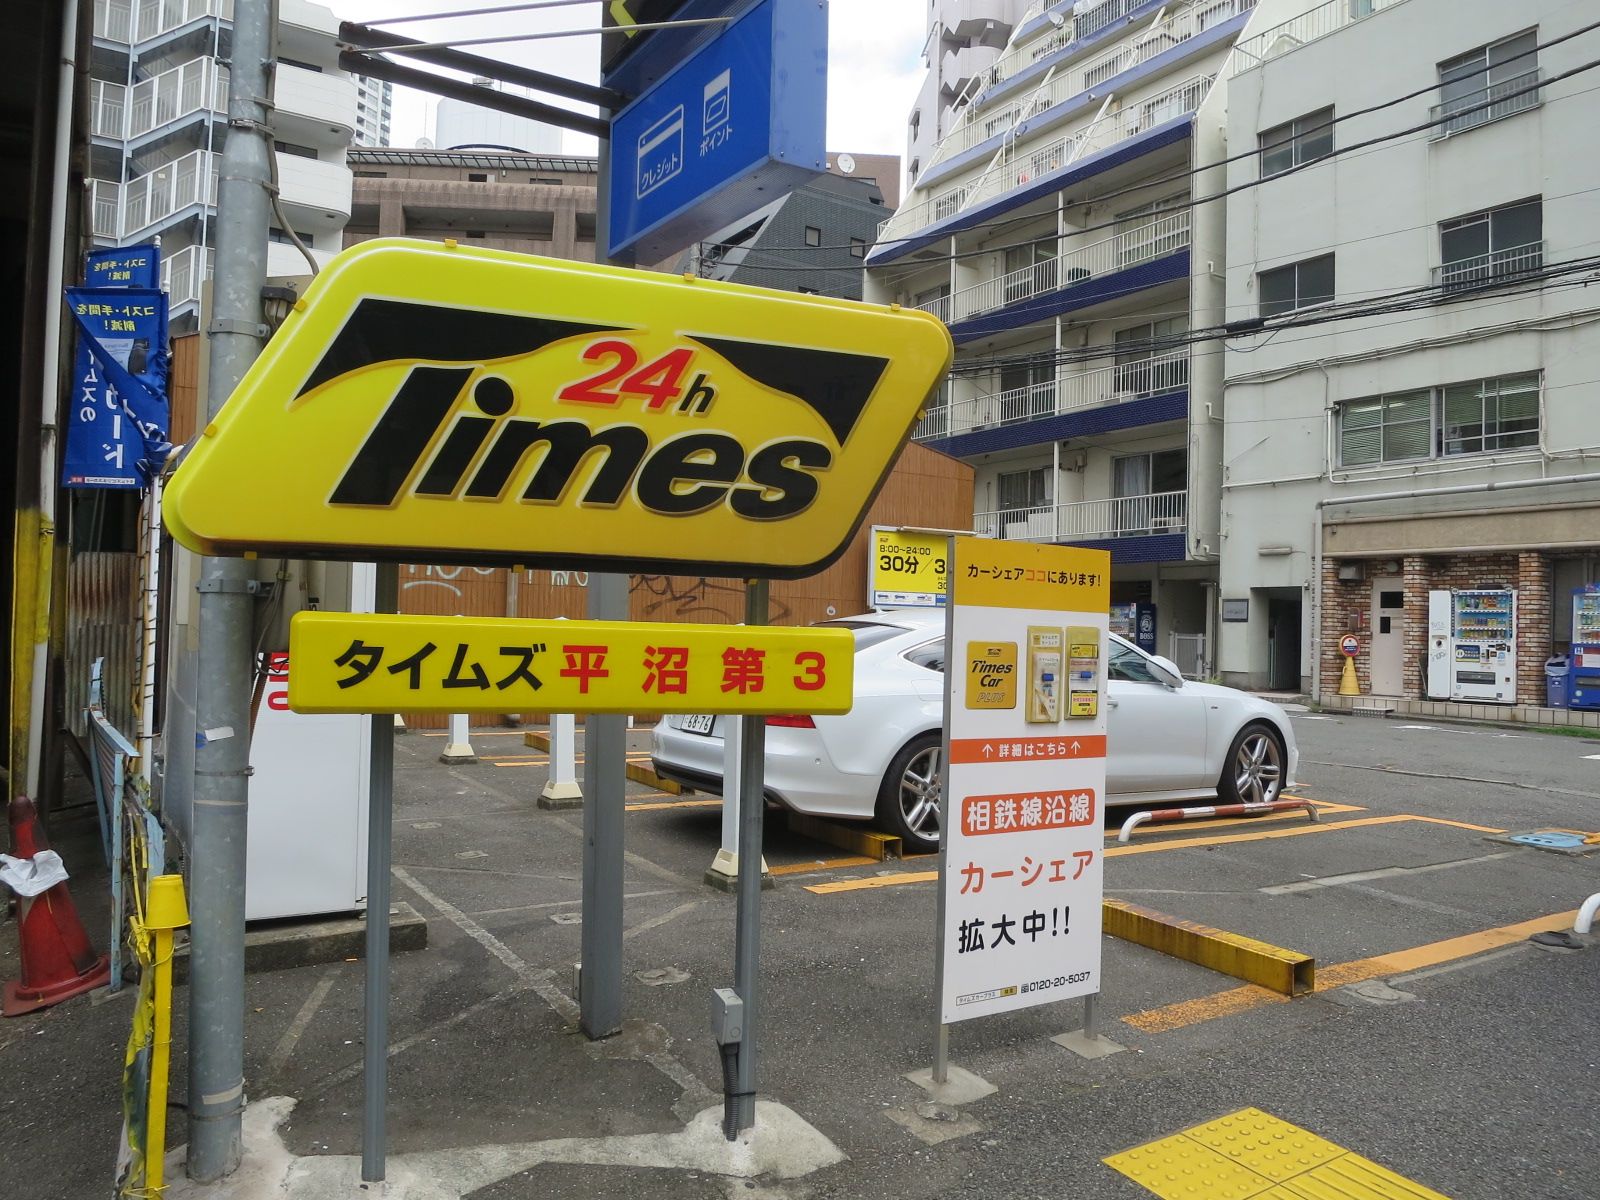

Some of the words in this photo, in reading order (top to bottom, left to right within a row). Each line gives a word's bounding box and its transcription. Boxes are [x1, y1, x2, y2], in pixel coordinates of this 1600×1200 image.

[699, 125, 733, 158] ポイント
[641, 152, 678, 190] クレジット
[557, 340, 717, 415] 24h
[328, 365, 832, 520] Times
[1139, 632, 1154, 640] BOSS
[971, 660, 1013, 673] Times
[980, 674, 1004, 688] Car
[998, 743, 1067, 758] 詳細はこちら
[967, 793, 1090, 832] 相鉄線沿線
[960, 850, 1094, 895] カーシェア
[958, 906, 1071, 954] 拡大中!!
[1029, 971, 1091, 992] 0120-20-5037
